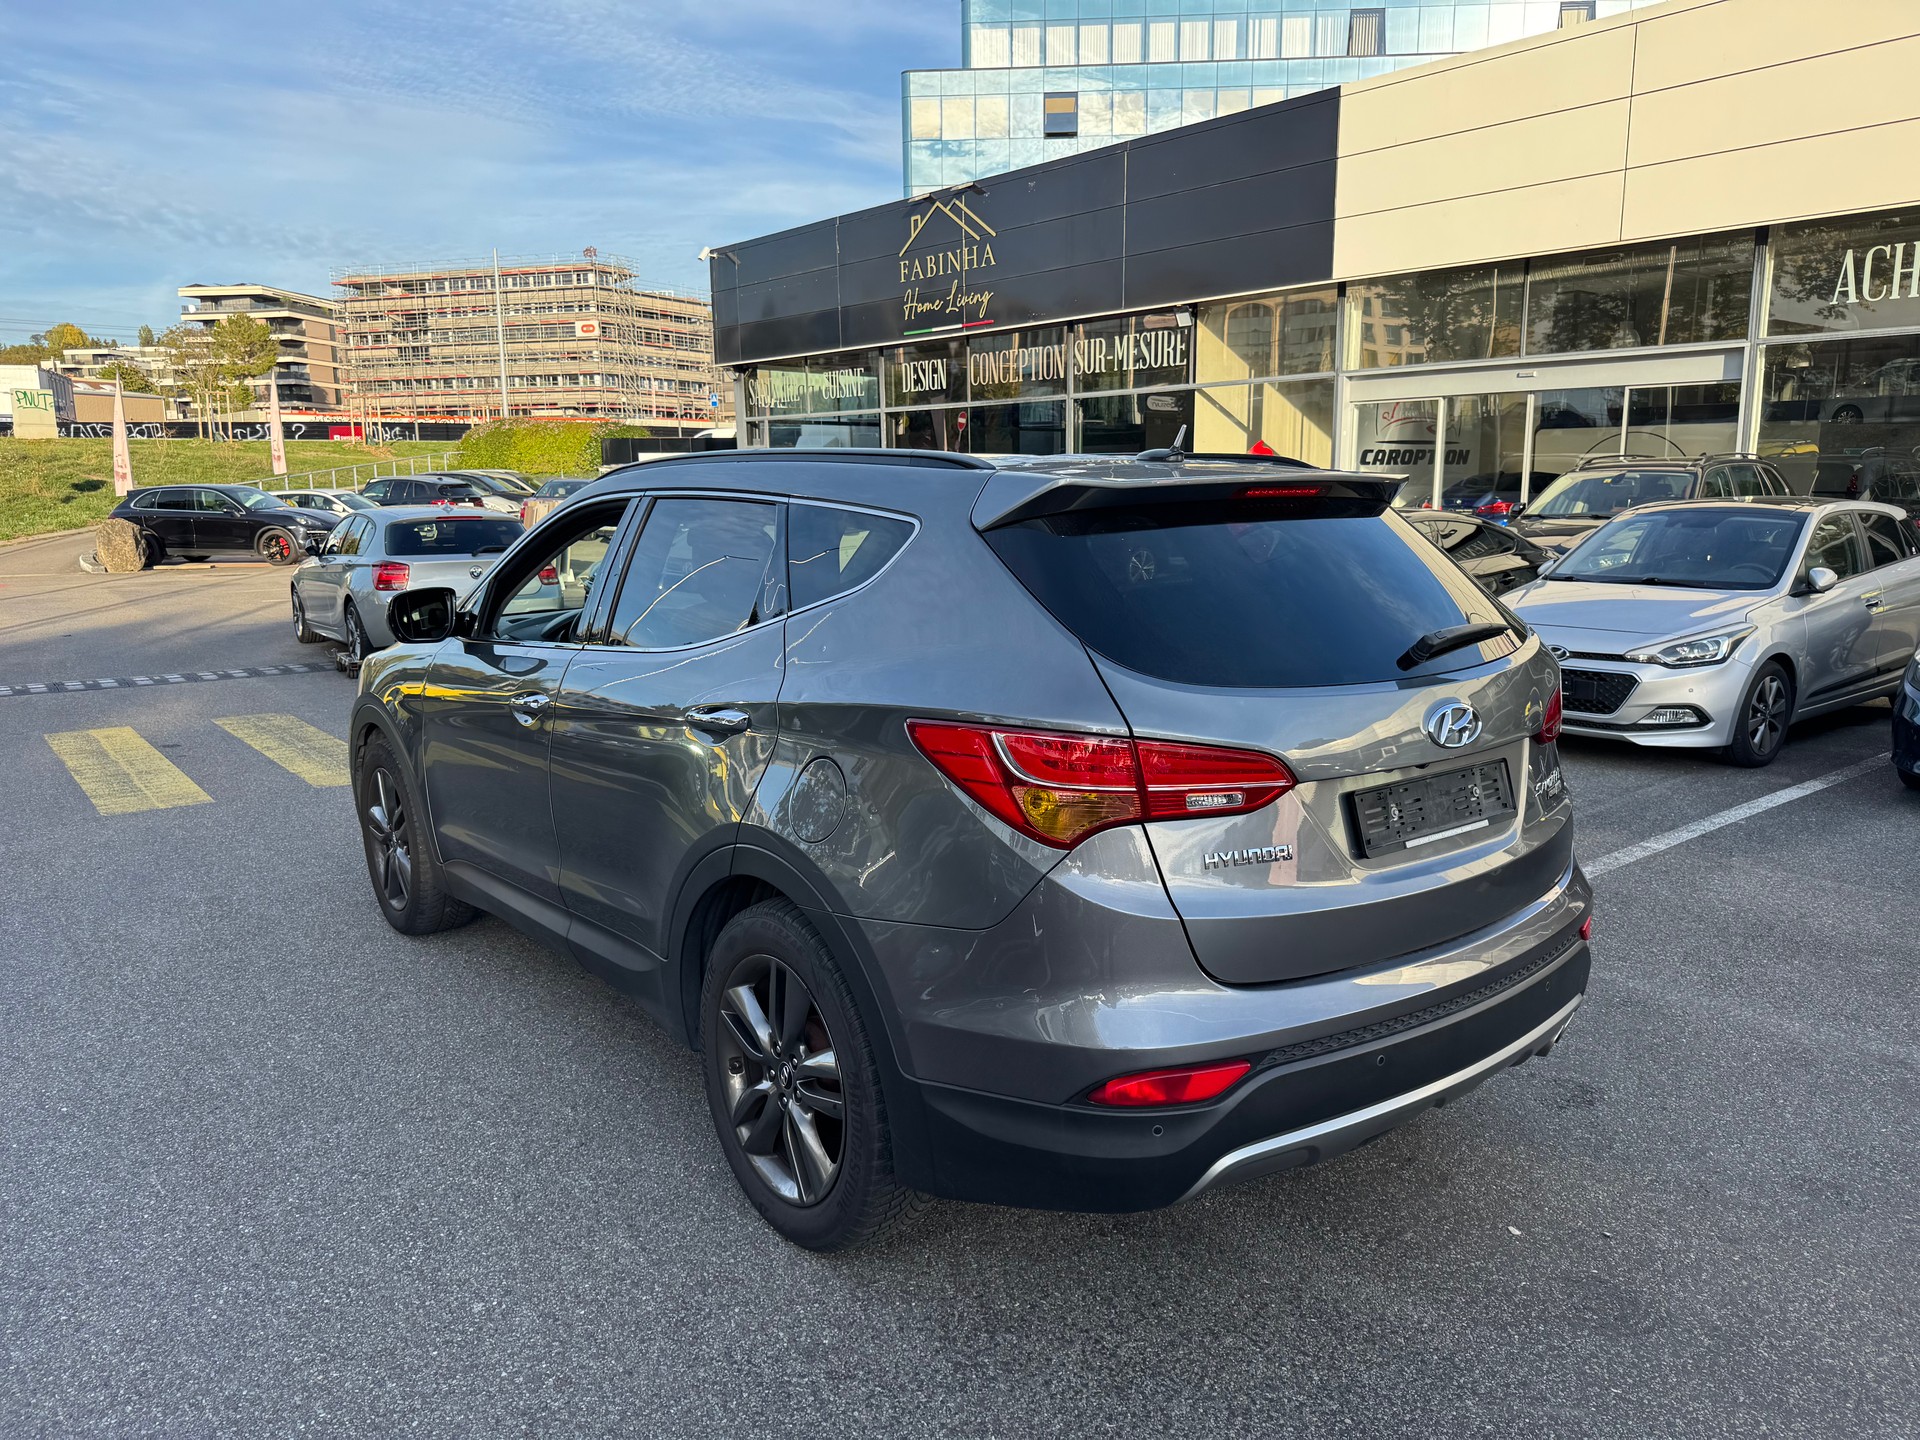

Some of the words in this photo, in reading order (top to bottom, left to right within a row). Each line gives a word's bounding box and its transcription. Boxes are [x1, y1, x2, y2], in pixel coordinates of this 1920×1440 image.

[899, 243, 997, 283] FABINHA
[1829, 241, 1920, 305] ACH
[903, 287, 943, 321] Home
[946, 279, 994, 319] Living
[902, 358, 947, 393] DESIGN
[970, 344, 1065, 386] CONCEPTION
[1074, 329, 1187, 376] SUR-MESURE
[822, 367, 865, 400] CUISINE
[1360, 449, 1470, 466] CAROPTON
[1203, 844, 1293, 870] HYUNDAI
